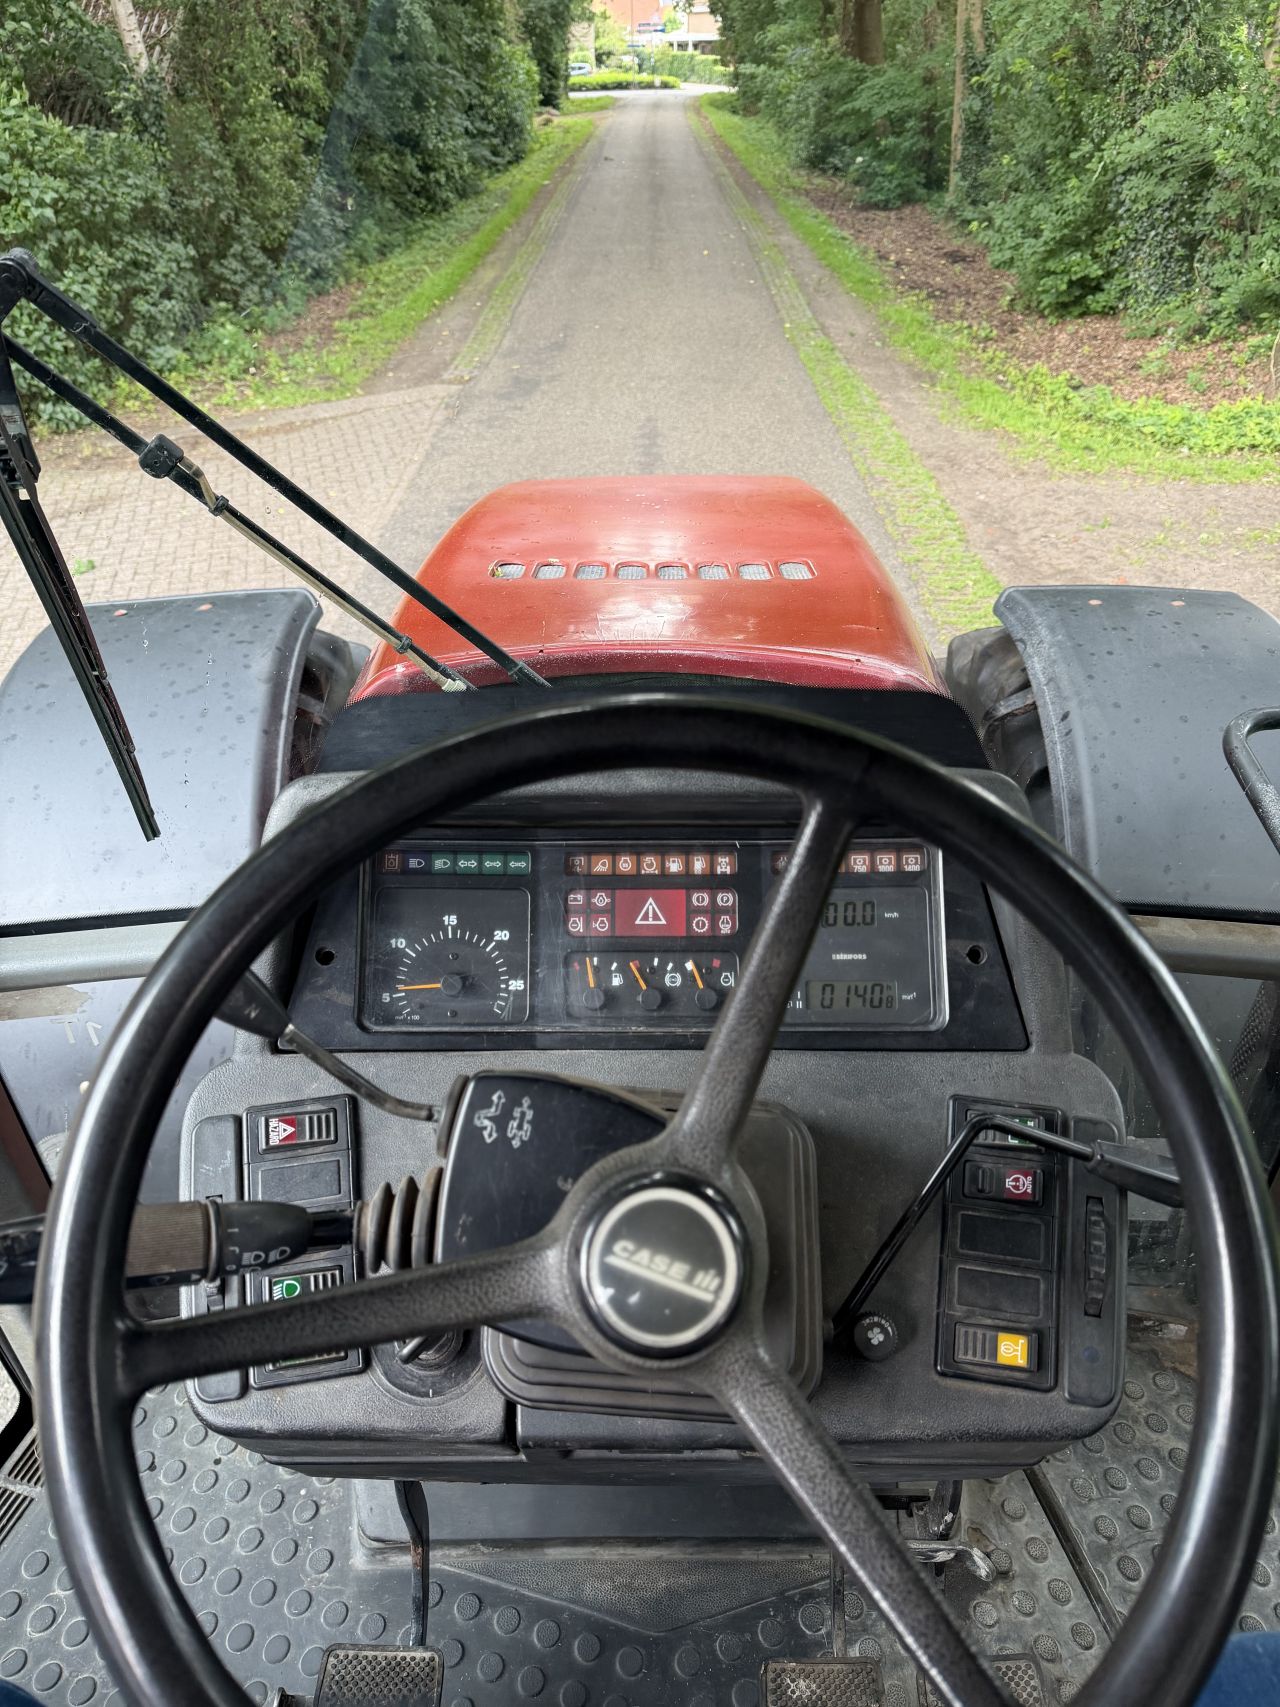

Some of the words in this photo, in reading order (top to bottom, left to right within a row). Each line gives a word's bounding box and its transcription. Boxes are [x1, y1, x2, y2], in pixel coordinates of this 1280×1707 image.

[443, 915, 457, 925] 15
[493, 930, 510, 941] 20
[390, 938, 406, 949] 10
[508, 980, 524, 991] 25
[381, 993, 391, 1003] 5
[268, 1118, 280, 1146] HAZARD
[612, 1239, 691, 1281] CASE
